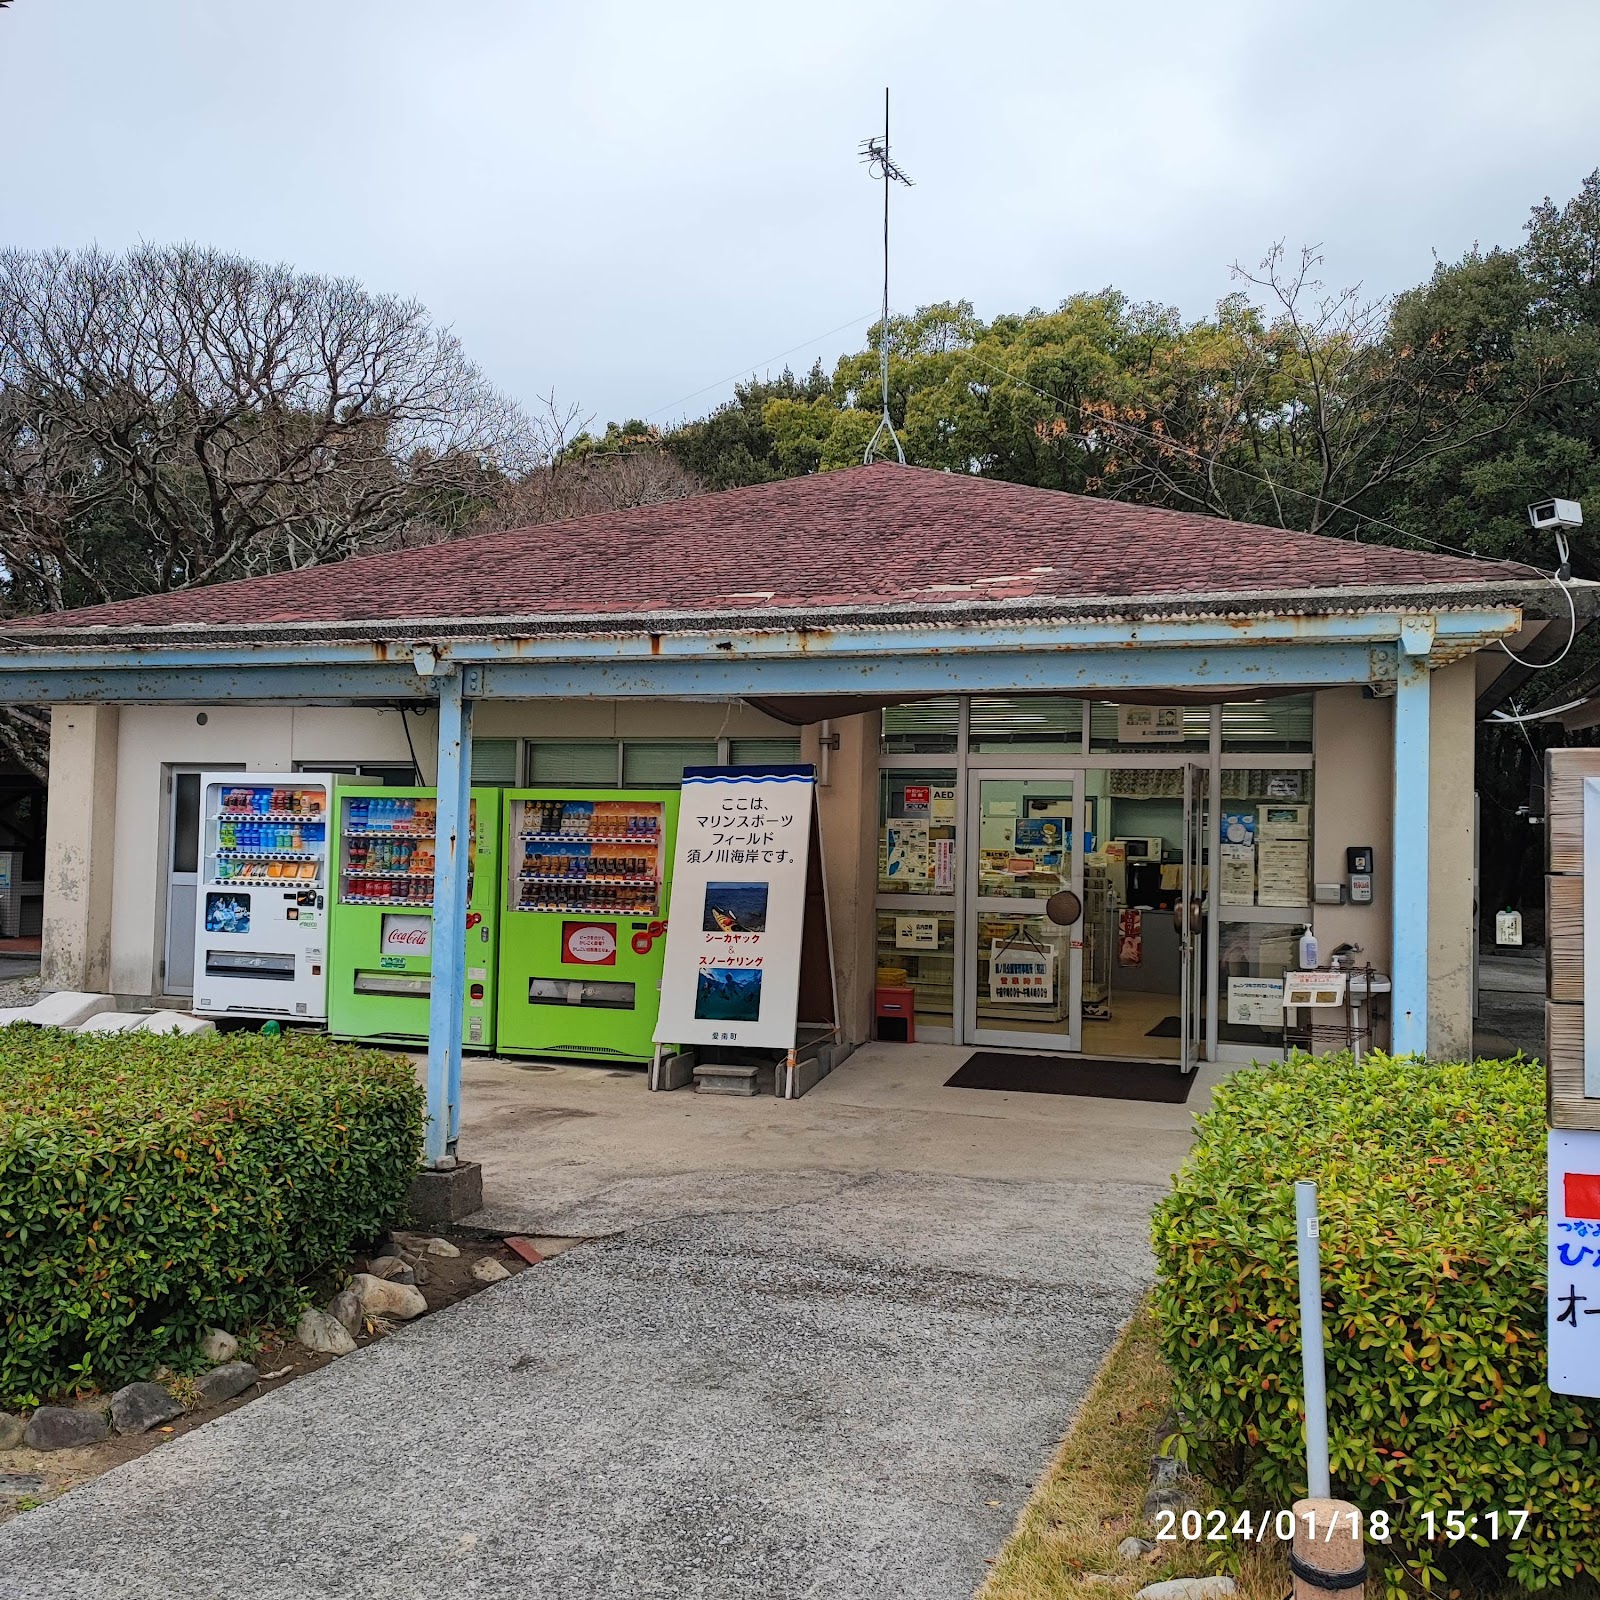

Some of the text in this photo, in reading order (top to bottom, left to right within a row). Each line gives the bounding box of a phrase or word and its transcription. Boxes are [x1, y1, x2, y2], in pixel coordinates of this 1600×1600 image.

[933, 791, 954, 799] AED
[722, 797, 770, 811] ここは、
[696, 814, 794, 828] マリンスポーツ
[712, 832, 774, 846] フィールド
[687, 849, 795, 864] 須ノ川海岸です。
[705, 933, 760, 944] シーカヤック
[727, 945, 735, 954] &
[699, 956, 764, 967] スノーケリング
